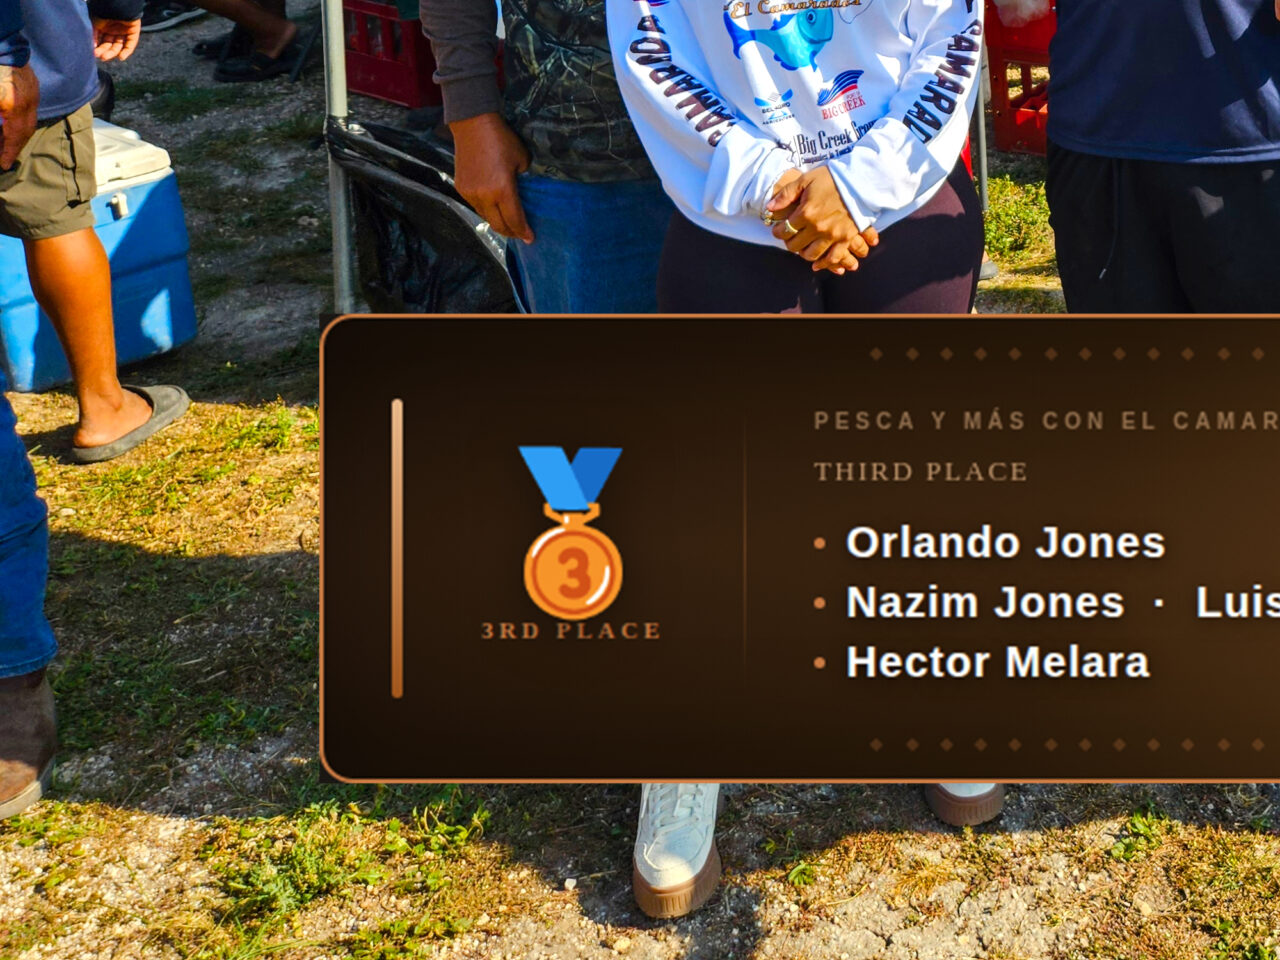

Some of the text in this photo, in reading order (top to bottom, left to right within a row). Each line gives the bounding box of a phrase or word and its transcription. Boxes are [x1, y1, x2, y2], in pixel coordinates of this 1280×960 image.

[821, 96, 866, 120] BIG CREEK
[796, 133, 817, 156] Big
[819, 130, 854, 151] Creek
